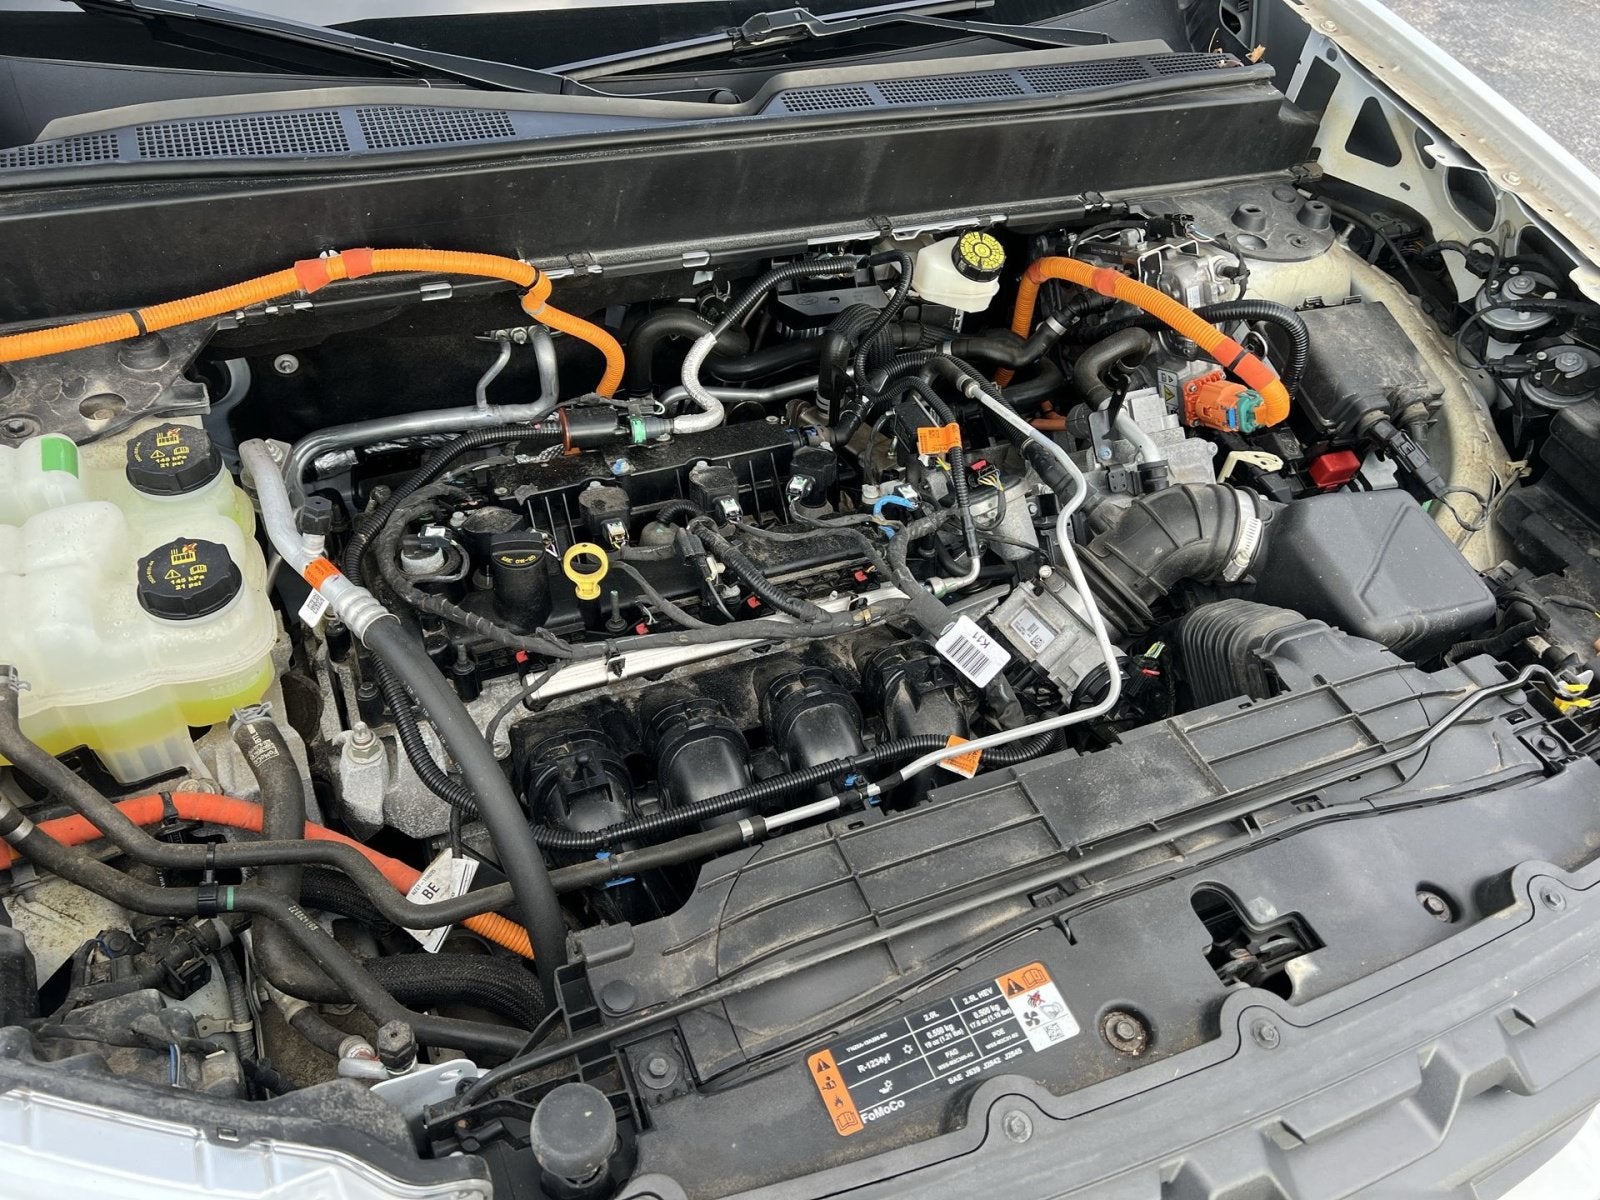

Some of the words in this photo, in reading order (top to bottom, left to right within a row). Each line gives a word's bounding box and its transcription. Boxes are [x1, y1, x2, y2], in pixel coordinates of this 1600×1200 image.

[170, 577, 186, 585] 145
[421, 882, 440, 900] BE
[962, 994, 979, 1006] 2.5L
[977, 987, 994, 999] HEV
[923, 1010, 940, 1022] 2.0L
[972, 1005, 992, 1019] 0.500
[989, 1003, 1001, 1012] kg
[980, 1017, 990, 1025] oz
[924, 1040, 933, 1049] 19
[931, 1038, 941, 1046] oz
[939, 1033, 954, 1044] (1.21
[951, 1028, 965, 1039] lbs)
[926, 1025, 945, 1040] 0.550
[943, 1022, 955, 1032] kg
[991, 1028, 1006, 1038] POE
[944, 1048, 959, 1058] PAG
[857, 1053, 892, 1073] R-1234yf
[947, 1073, 964, 1085] SAE
[965, 1066, 981, 1078] J639
[982, 1057, 1002, 1070] J2842
[1004, 1048, 1023, 1061] J2845
[860, 1099, 906, 1124] FoMoCo
